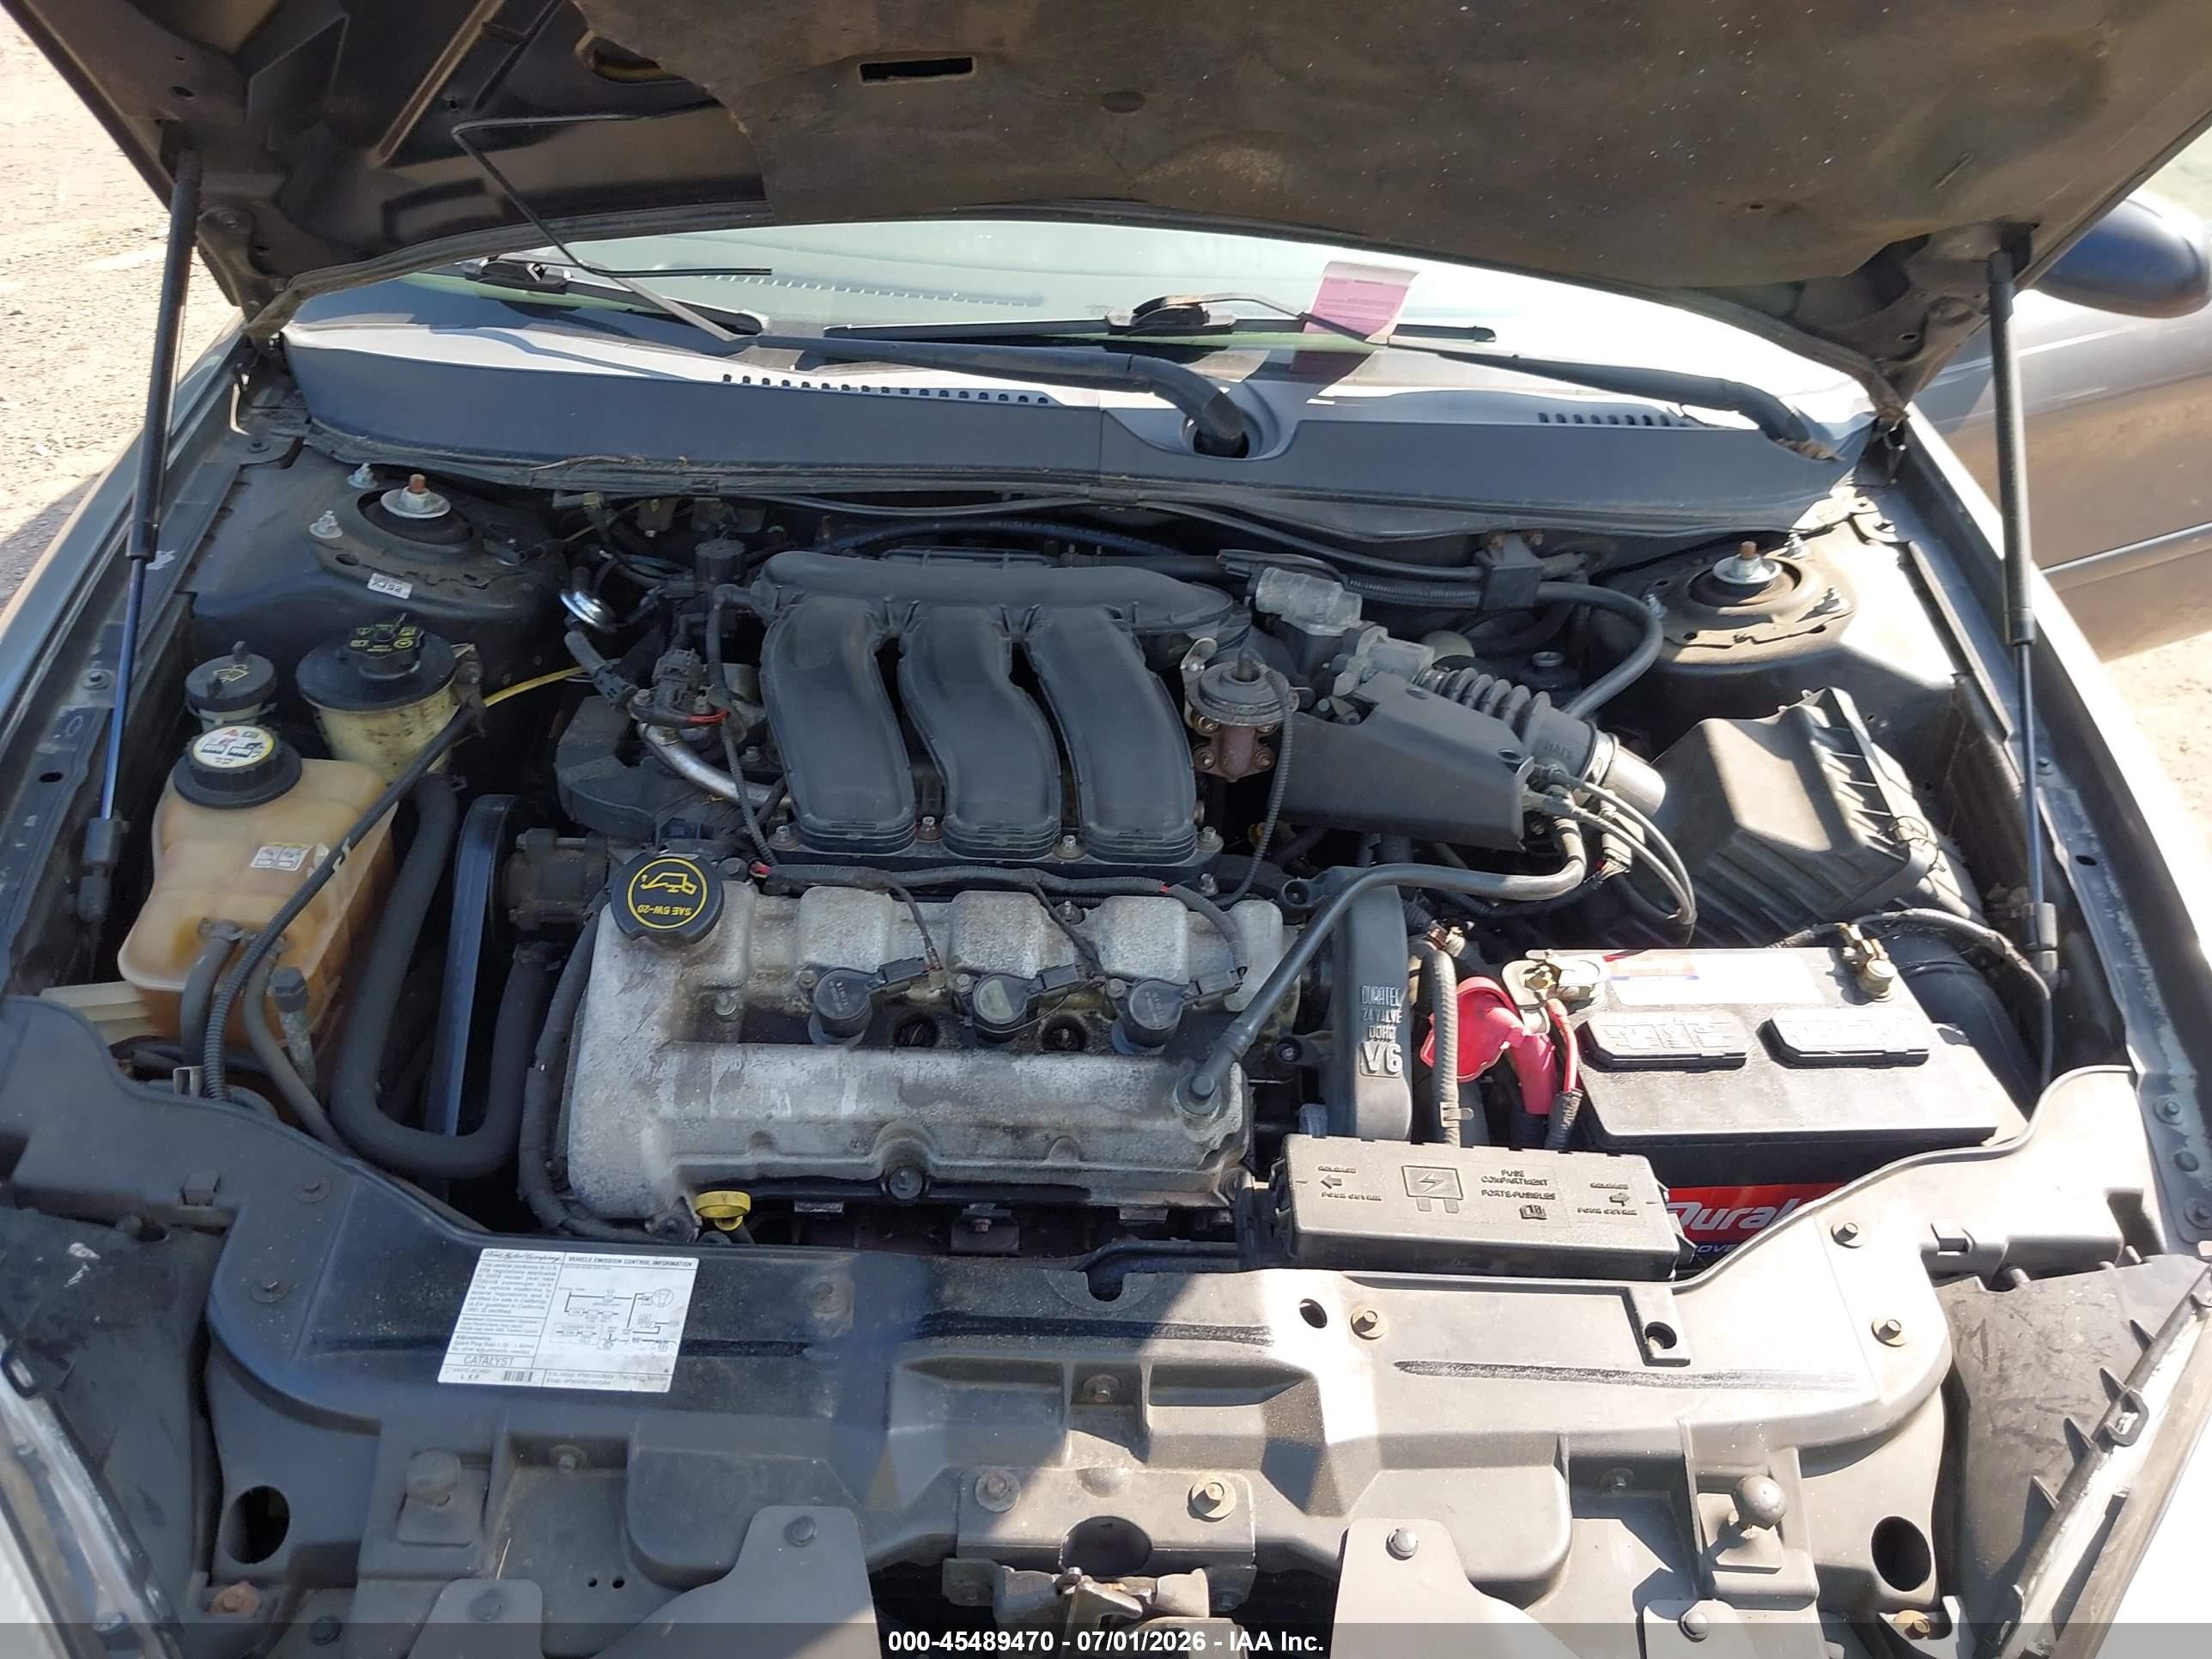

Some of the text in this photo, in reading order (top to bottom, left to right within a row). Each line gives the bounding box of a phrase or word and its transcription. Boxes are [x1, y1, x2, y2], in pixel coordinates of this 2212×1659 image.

[637, 904, 692, 916] SAE 5W-20
[1361, 985, 1402, 1006] DURATEC
[1375, 1008, 1402, 1024] VALVE
[1360, 1042, 1403, 1074] V6
[1500, 1169, 1525, 1177] FUSE
[464, 1355, 516, 1367] CATALYST
